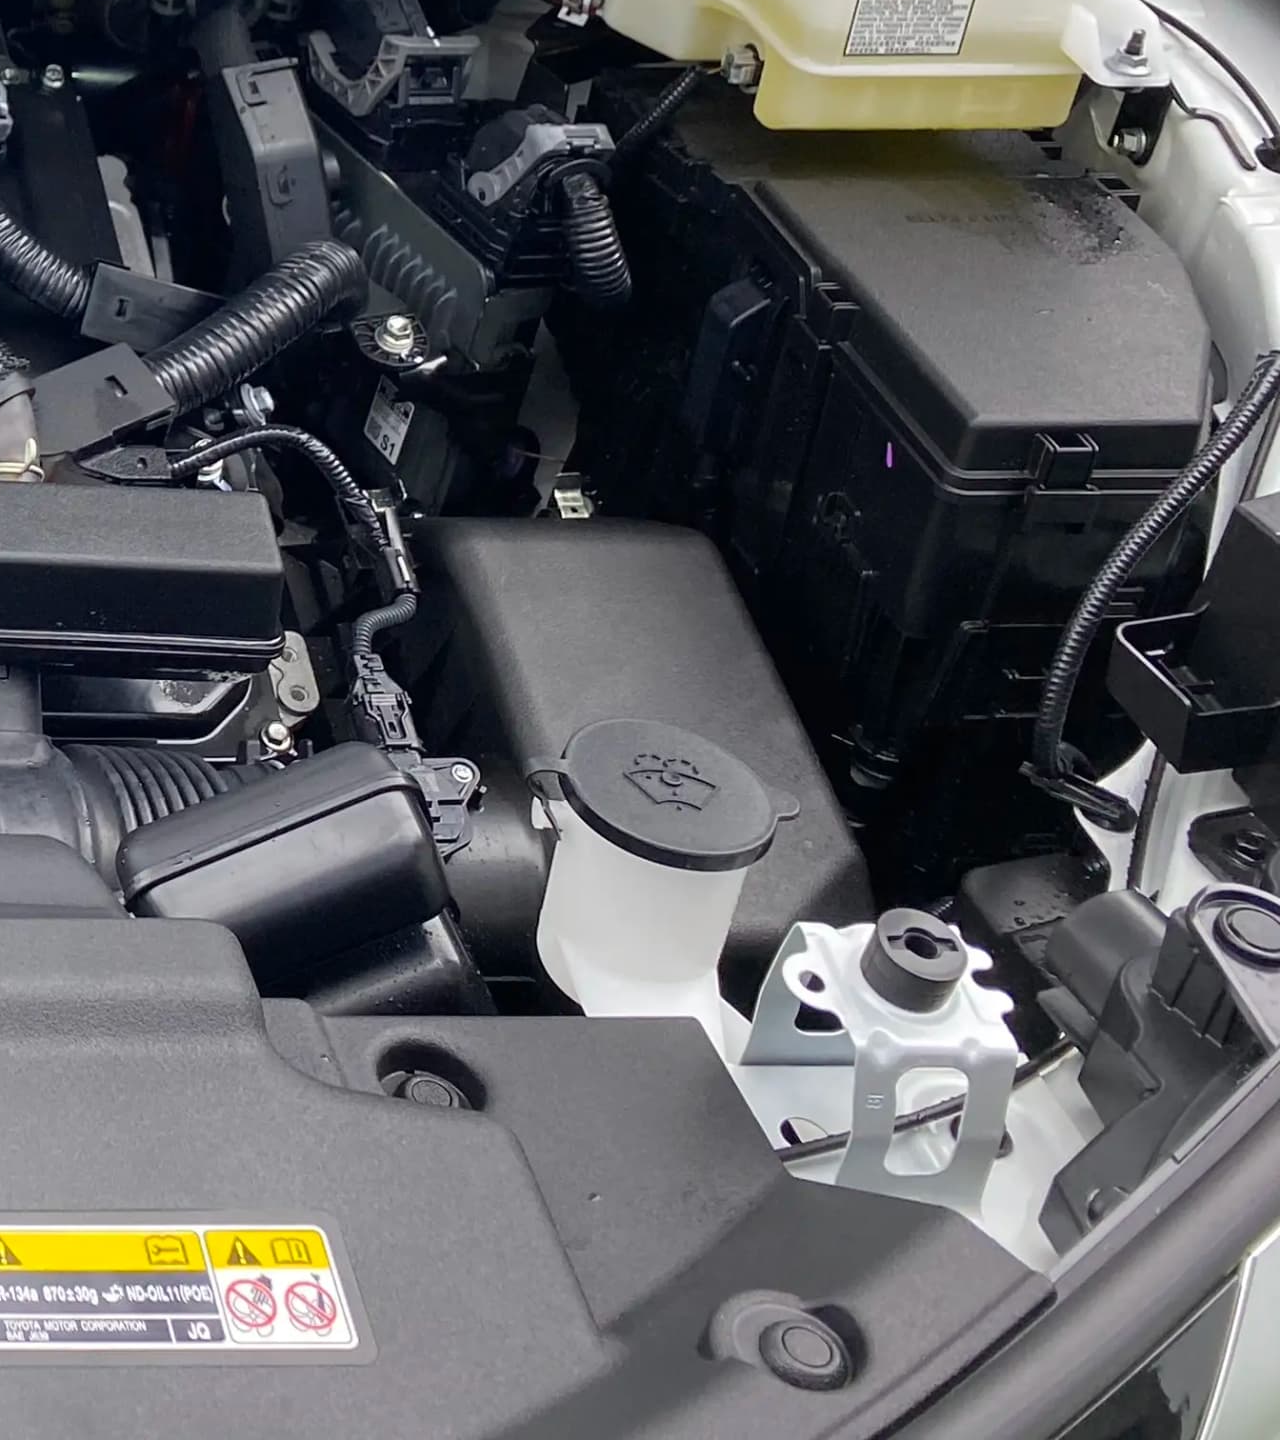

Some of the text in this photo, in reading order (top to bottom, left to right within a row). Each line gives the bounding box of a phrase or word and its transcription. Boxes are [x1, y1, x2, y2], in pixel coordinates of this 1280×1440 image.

[380, 434, 396, 459] S1
[127, 1285, 213, 1304] ND-OIL11(POE)
[3, 1320, 147, 1332] TOYOTA MOTOR CORPORATION
[188, 1322, 212, 1340] JQ
